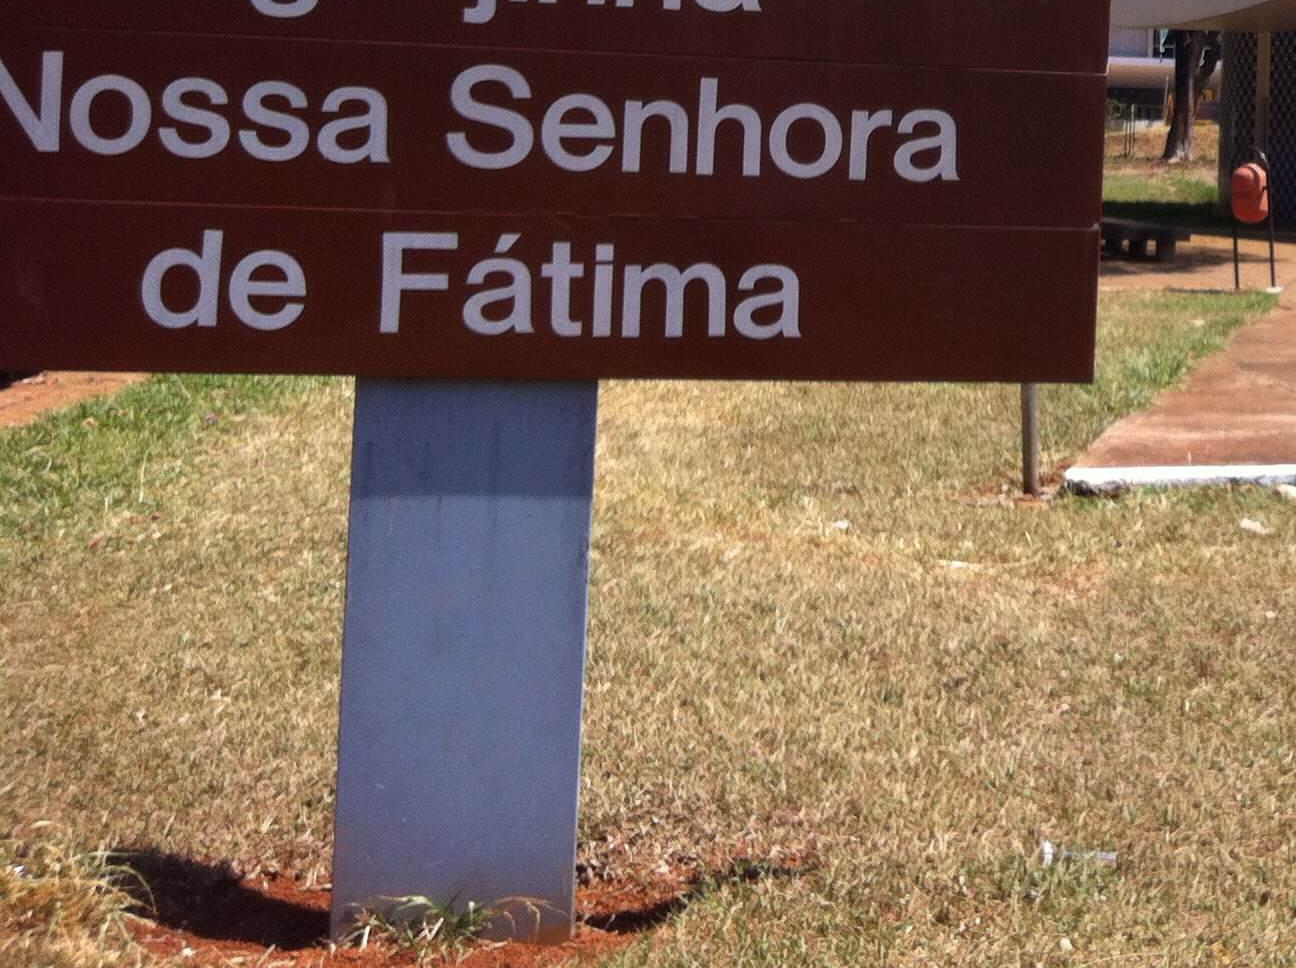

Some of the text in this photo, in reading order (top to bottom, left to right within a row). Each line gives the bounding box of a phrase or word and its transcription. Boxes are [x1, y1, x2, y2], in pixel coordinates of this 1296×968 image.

[0, 50, 960, 182] Nossa Senhora
[141, 229, 801, 339] de Fátima
